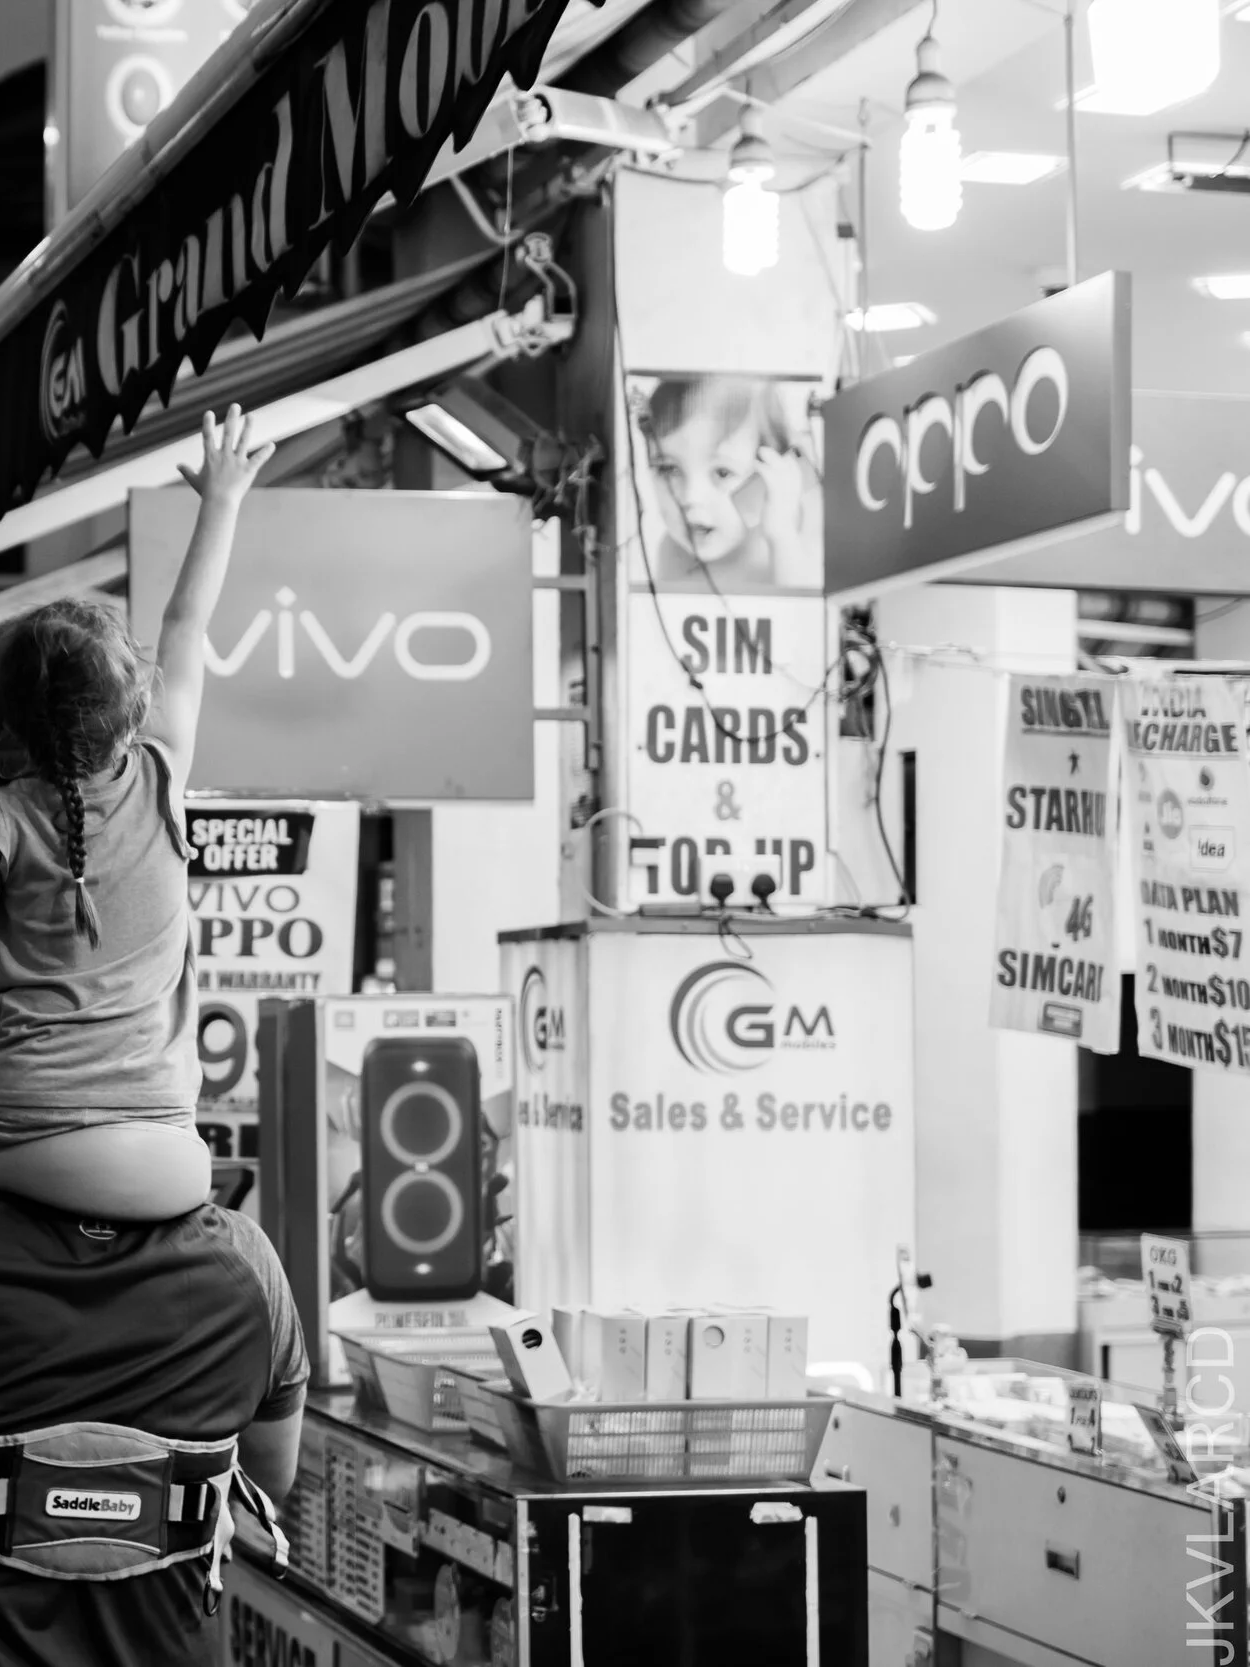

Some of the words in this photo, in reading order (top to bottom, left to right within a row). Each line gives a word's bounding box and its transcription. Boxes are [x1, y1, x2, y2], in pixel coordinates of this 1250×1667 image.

[96, 90, 293, 396] Grand
[203, 585, 492, 682] vivo
[681, 614, 773, 675] SIM
[645, 704, 809, 766] CARDS
[1127, 719, 1240, 754] ECHARGE
[715, 779, 743, 822] &
[191, 818, 293, 847] SPECIAL
[203, 844, 280, 872] OFFER
[630, 836, 731, 896] TO
[1181, 885, 1240, 917] PLAN
[1143, 917, 1154, 946] 1
[1146, 962, 1158, 994] 2
[725, 1004, 834, 1049] GM
[1149, 1006, 1163, 1051] 3
[609, 1090, 708, 1132] Sales
[719, 1091, 744, 1132] &
[756, 1091, 893, 1132] Service
[52, 1495, 135, 1516] SaddleBaby
